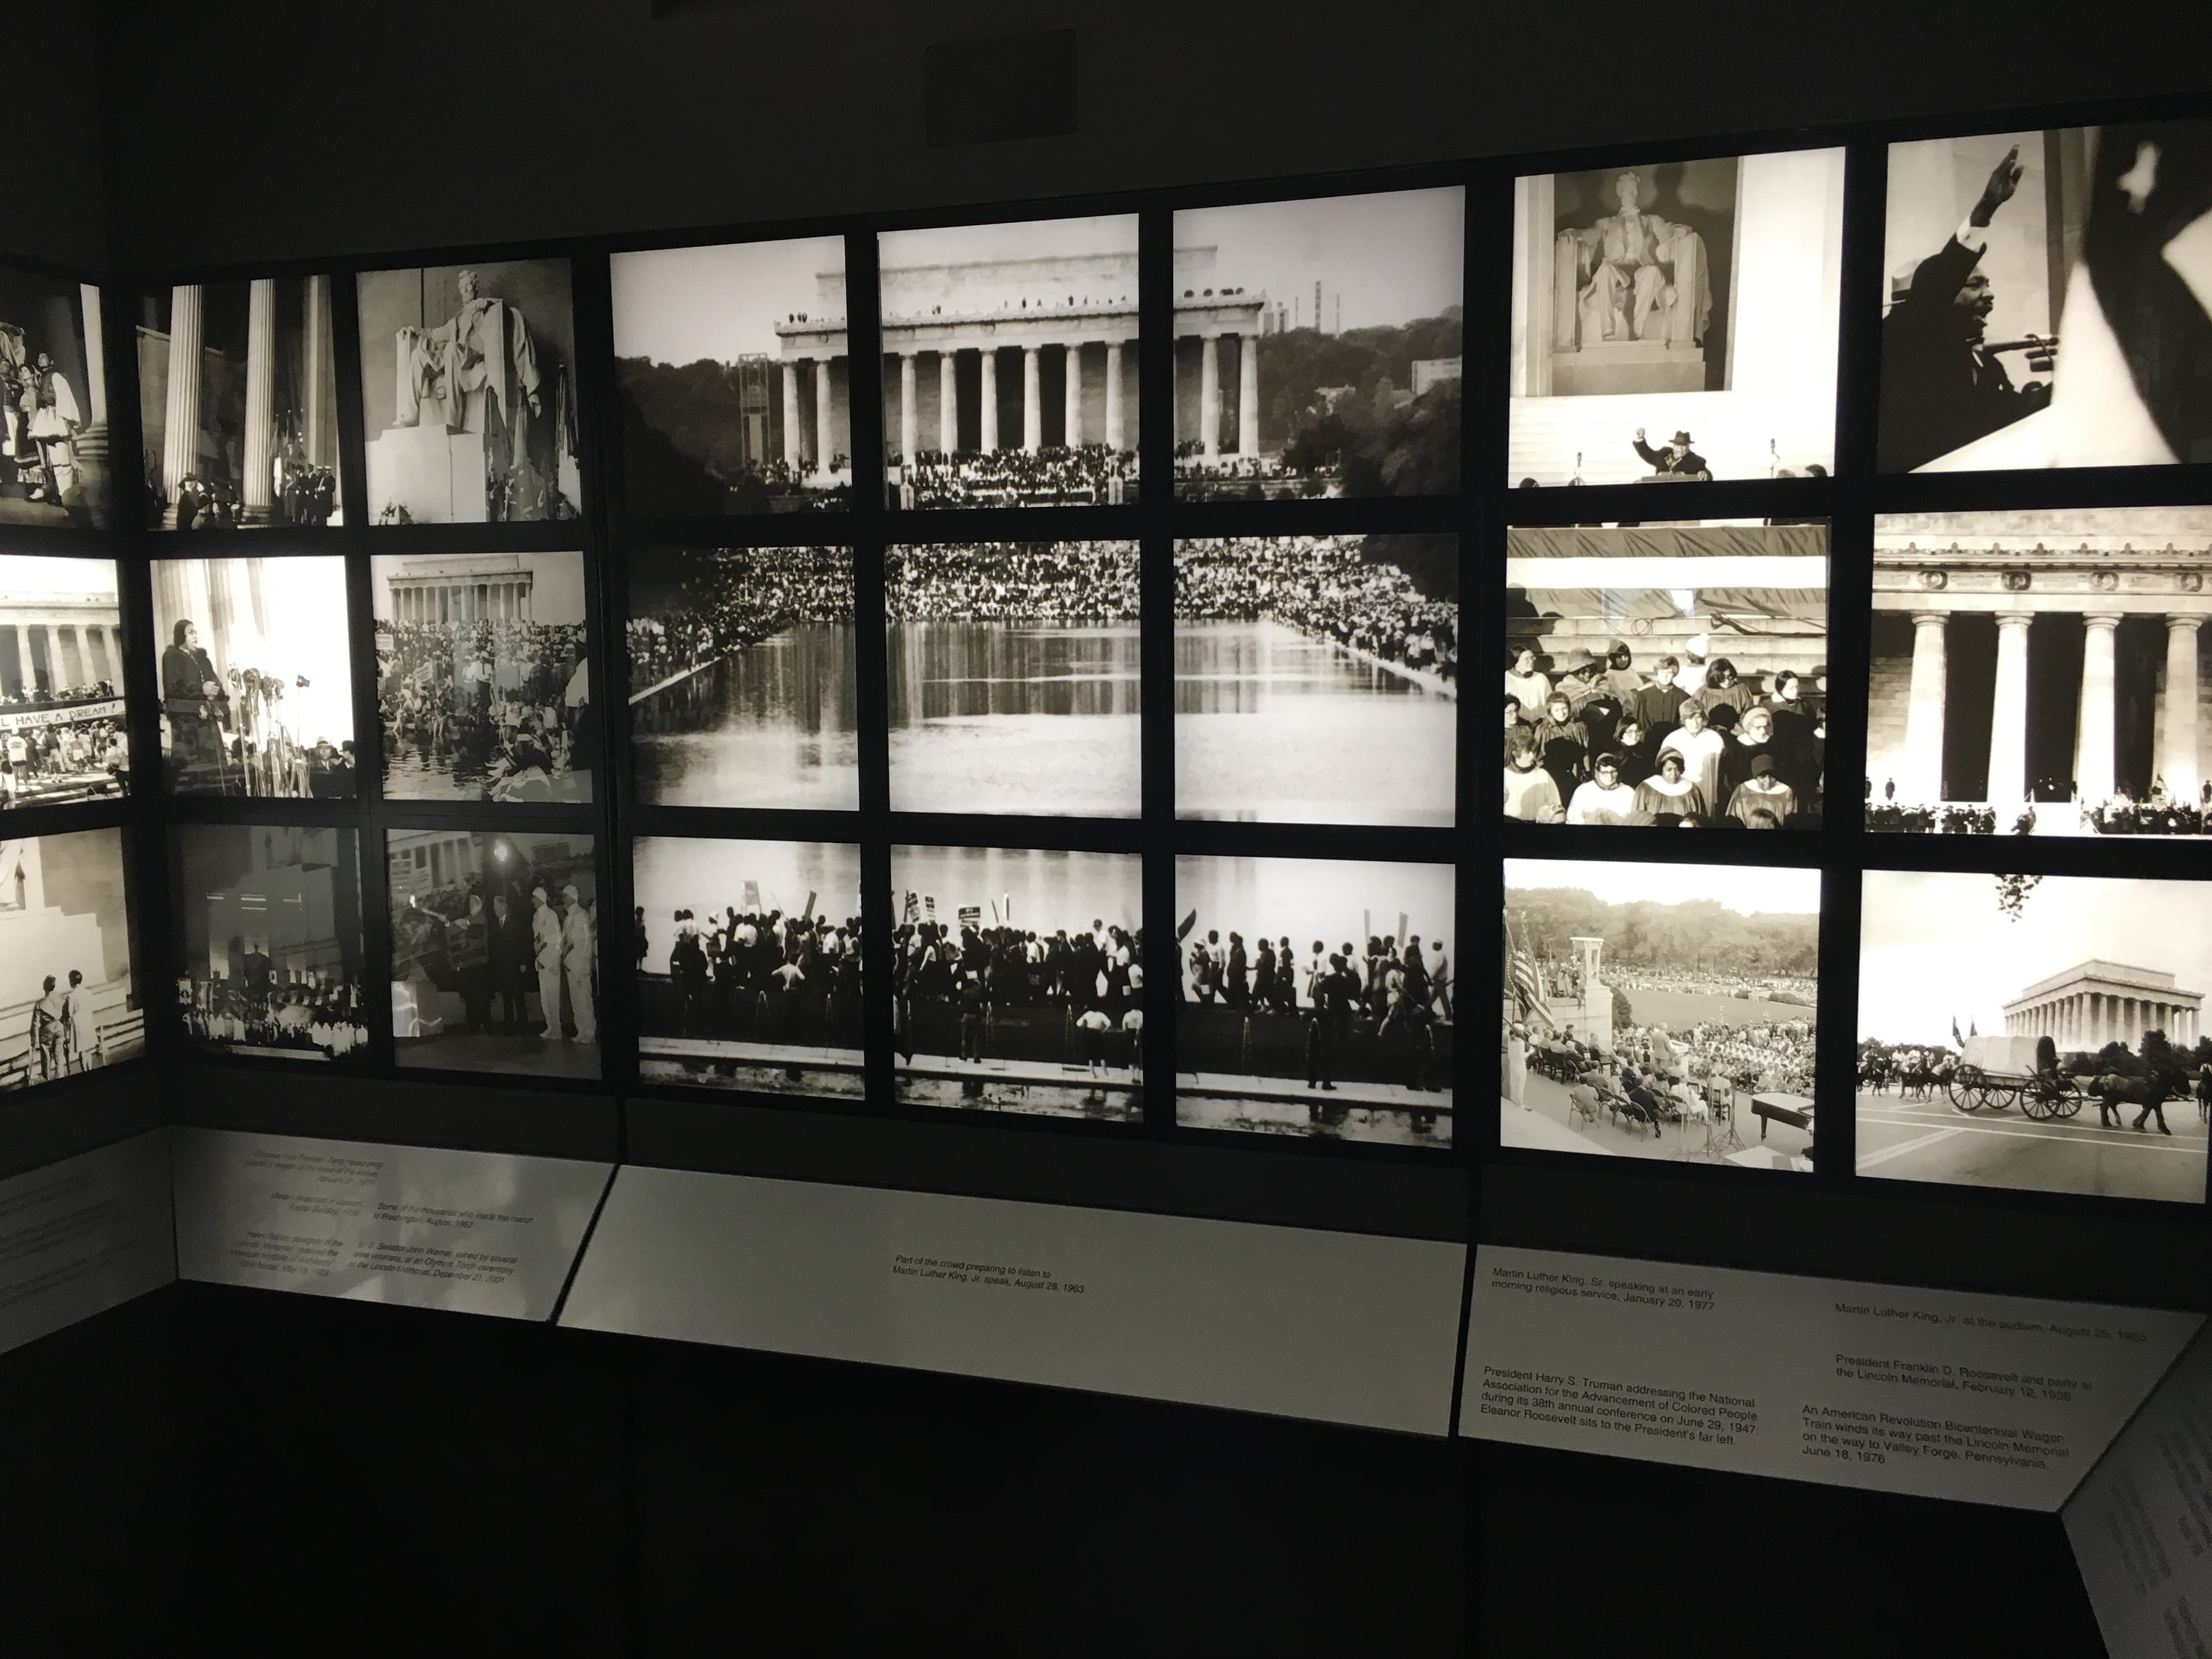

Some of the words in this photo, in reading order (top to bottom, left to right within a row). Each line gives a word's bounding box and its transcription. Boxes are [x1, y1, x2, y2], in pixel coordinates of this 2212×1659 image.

[16, 714, 50, 725] HAVE
[55, 713, 63, 721] A
[69, 706, 107, 718] DREAM
[892, 1265, 918, 1275] Martin
[919, 1268, 947, 1279] Luther
[983, 1276, 1012, 1286] speak,
[1013, 1279, 1045, 1289] August
[1045, 1282, 1059, 1292] 28,
[1063, 1283, 1085, 1294] 1963
[895, 1255, 914, 1264] Part
[914, 1257, 924, 1265] of
[924, 1258, 938, 1267] the
[939, 1261, 965, 1270] crowd
[965, 1264, 1006, 1275] preparing
[1007, 1267, 1017, 1275] to
[1017, 1267, 1041, 1277] listen
[1042, 1270, 1052, 1279] to
[1491, 1281, 1533, 1293] morning
[1535, 1285, 1578, 1296] religious
[1623, 1293, 1665, 1308] January
[1688, 1300, 1715, 1311] 1977
[1493, 1268, 1524, 1278] Martin
[1526, 1271, 1559, 1282] Luther
[1608, 1281, 1656, 1294] speaking
[1687, 1290, 1714, 1301] early
[1835, 1303, 1870, 1315] Martin
[1873, 1306, 1910, 1319] Luther
[1963, 1317, 1976, 1326] at
[1977, 1317, 1997, 1328] the
[1835, 1354, 1891, 1369] President
[1893, 1360, 1940, 1374] Franklin
[1942, 1365, 1956, 1376] D.
[1959, 1367, 2018, 1382] Roosevelt
[2021, 1376, 2044, 1385] and
[1835, 1367, 1854, 1377] the
[1857, 1369, 1899, 1383] Lincoln
[1962, 1380, 2016, 1397] February
[1482, 1378, 1543, 1394] Association
[1545, 1386, 1560, 1396] for
[1562, 1388, 1579, 1399] the
[1581, 1391, 1656, 1408] Advancement
[1658, 1401, 1669, 1410] of
[1671, 1402, 1715, 1416] Colored
[1718, 1407, 1758, 1422] People
[1484, 1366, 1533, 1380] President
[1535, 1373, 1565, 1386] Harry
[1567, 1376, 1580, 1385] S.
[1582, 1377, 1623, 1391] Truman
[1626, 1384, 1686, 1401] addressing
[1688, 1391, 1706, 1402] the
[1709, 1393, 1755, 1408] National
[1480, 1404, 1521, 1418] Eleanor
[1524, 1409, 1577, 1425] Roosevelt
[1579, 1418, 1598, 1428] sits
[1600, 1420, 1612, 1429] to
[1614, 1422, 1631, 1432] the
[1634, 1423, 1696, 1440] President's
[1698, 1431, 1714, 1442] far
[1481, 1392, 1514, 1406] during
[1516, 1396, 1529, 1406] its
[1532, 1397, 1555, 1408] 38th
[1558, 1403, 1594, 1414] annual
[1596, 1407, 1657, 1422] conference
[1660, 1416, 1674, 1424] on
[1677, 1416, 1704, 1428] June
[1707, 1419, 1724, 1431] 29,
[1801, 1404, 1819, 1415] An
[1821, 1407, 1876, 1422] American
[1879, 1412, 1942, 1429] Revolution
[1944, 1421, 2018, 1438] Bicentennial
[1801, 1417, 1832, 1430] Train
[1835, 1423, 1869, 1434] winds
[1872, 1427, 1885, 1437] its
[1888, 1430, 1912, 1441] way
[1915, 1433, 1941, 1443] past
[1944, 1435, 1963, 1446] the
[1966, 1437, 2009, 1450] Lincoln
[2012, 1442, 2070, 1457] Memorial
[1802, 1433, 1817, 1441] on
[1820, 1434, 1839, 1445] the
[1841, 1438, 1865, 1449] way
[1869, 1440, 1880, 1449] to
[1883, 1441, 1919, 1456] Valley
[1802, 1446, 1831, 1457] June
[1857, 1452, 1886, 1464] 1976
